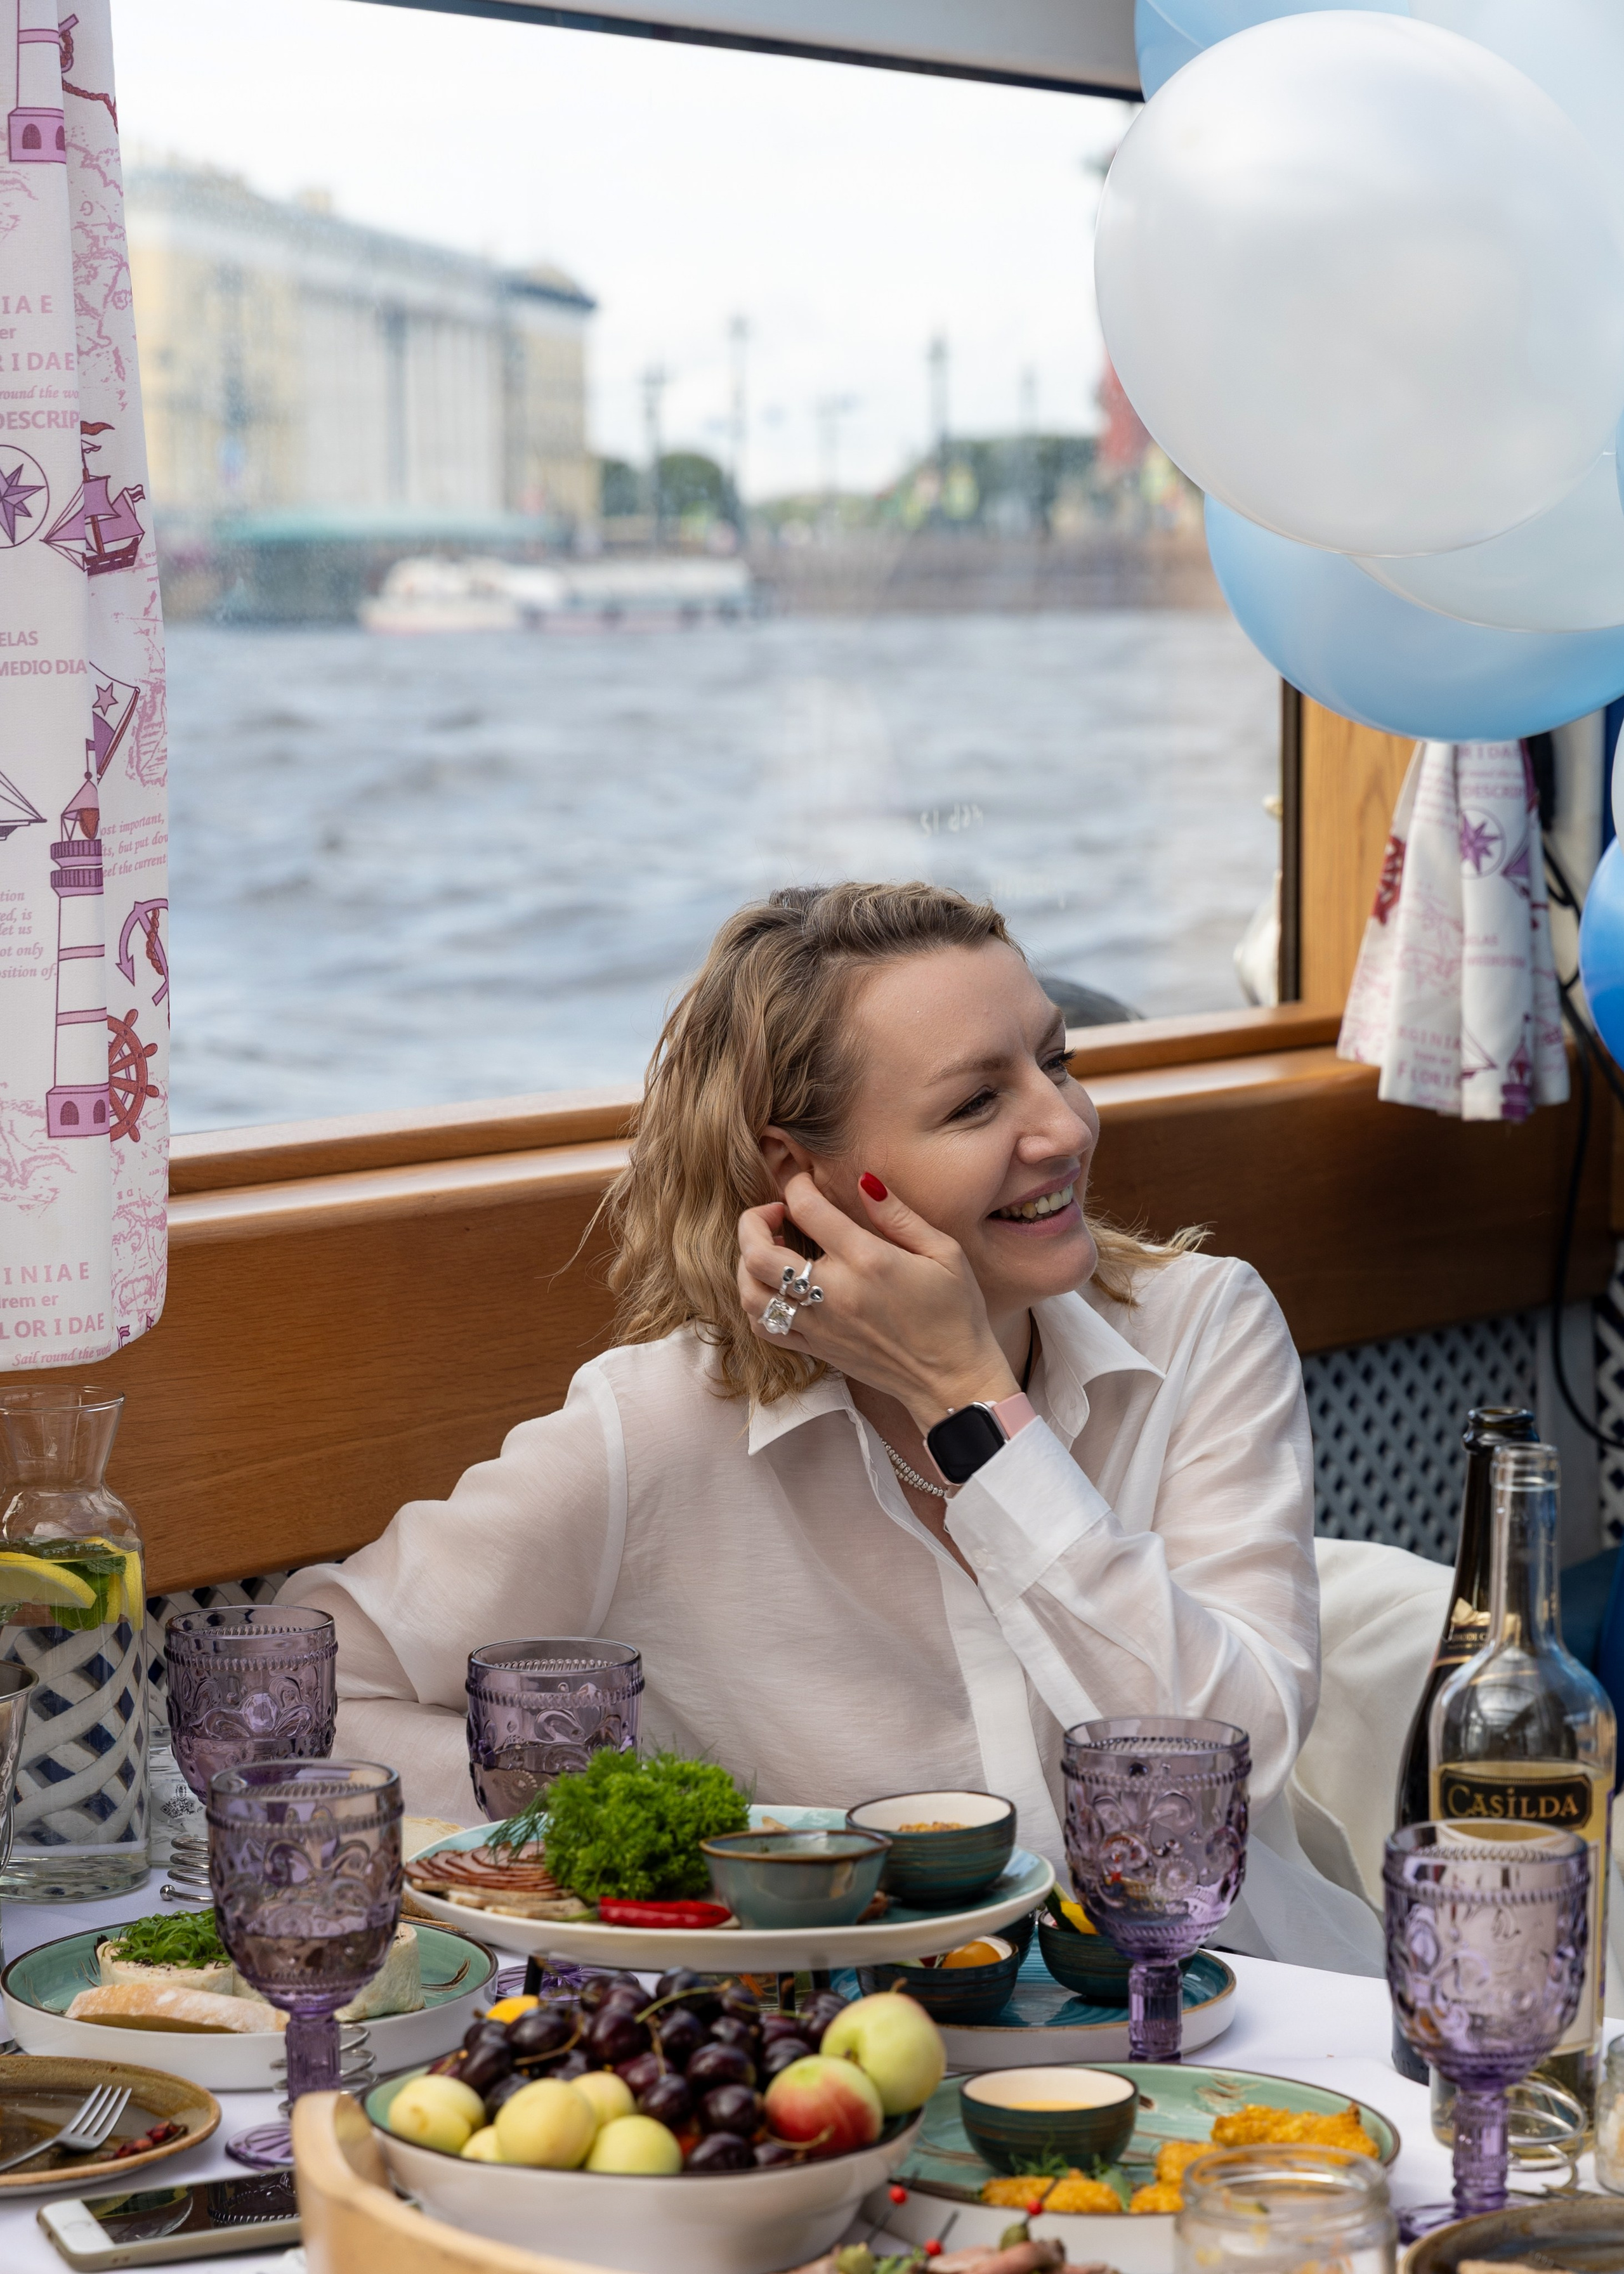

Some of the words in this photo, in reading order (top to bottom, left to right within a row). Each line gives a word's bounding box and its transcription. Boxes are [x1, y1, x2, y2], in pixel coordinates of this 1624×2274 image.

[39, 385, 59, 399] the
[56, 659, 88, 674] DIA
[119, 813, 164, 835] important,
[102, 844, 114, 858] ts,
[119, 840, 133, 854] but
[134, 837, 149, 854] put
[119, 860, 133, 875] the
[0, 889, 25, 901] tion
[0, 908, 17, 923] ed,
[21, 908, 32, 920] is
[18, 926, 32, 934] us
[16, 942, 44, 959] only
[0, 965, 37, 979] sition
[0, 1296, 36, 1309] rem
[41, 1295, 59, 1307] er
[12, 1350, 41, 1367] Sail
[41, 1347, 78, 1363] round
[78, 1346, 95, 1360] the
